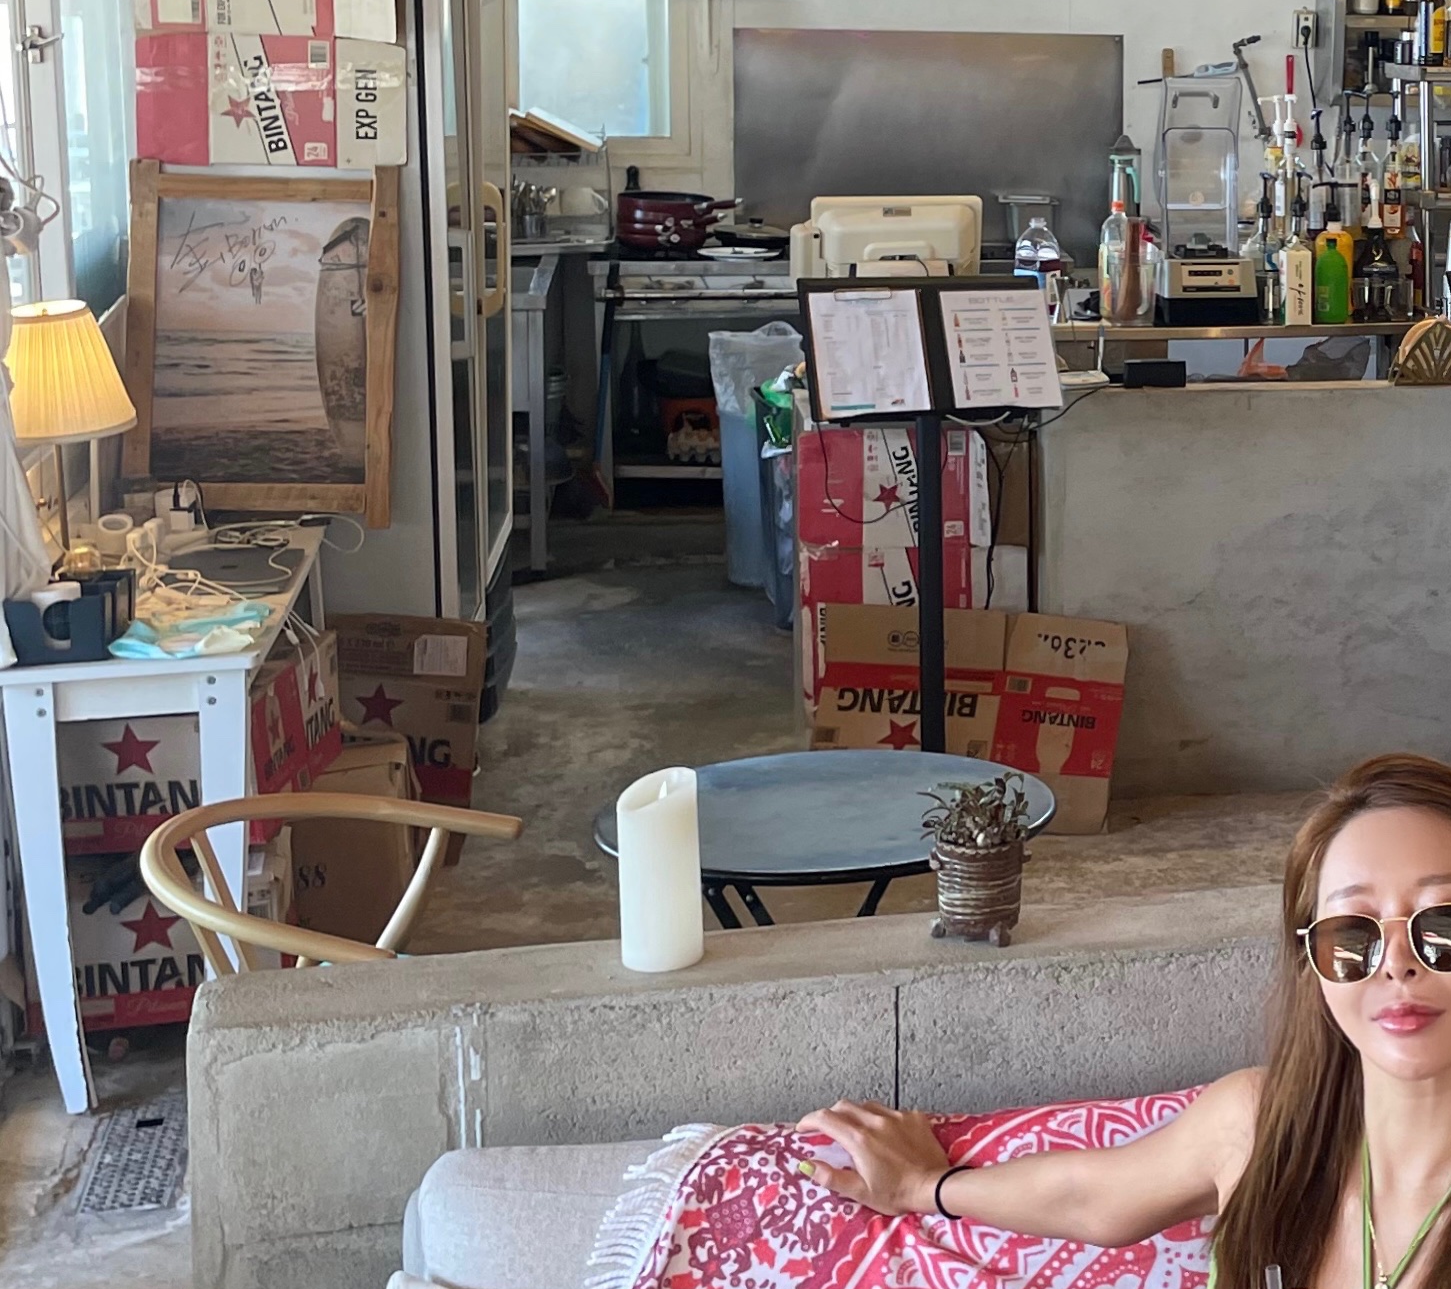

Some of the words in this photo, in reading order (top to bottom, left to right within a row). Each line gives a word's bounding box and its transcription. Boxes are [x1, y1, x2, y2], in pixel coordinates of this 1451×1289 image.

[354, 69, 378, 102] GEN
[355, 109, 378, 140] EXP
[968, 296, 1014, 305] BOTTLE
[837, 687, 978, 718] BITANG
[1021, 710, 1097, 729] BINTANG
[60, 779, 200, 819] BINTAN
[76, 954, 204, 996] INTAN
